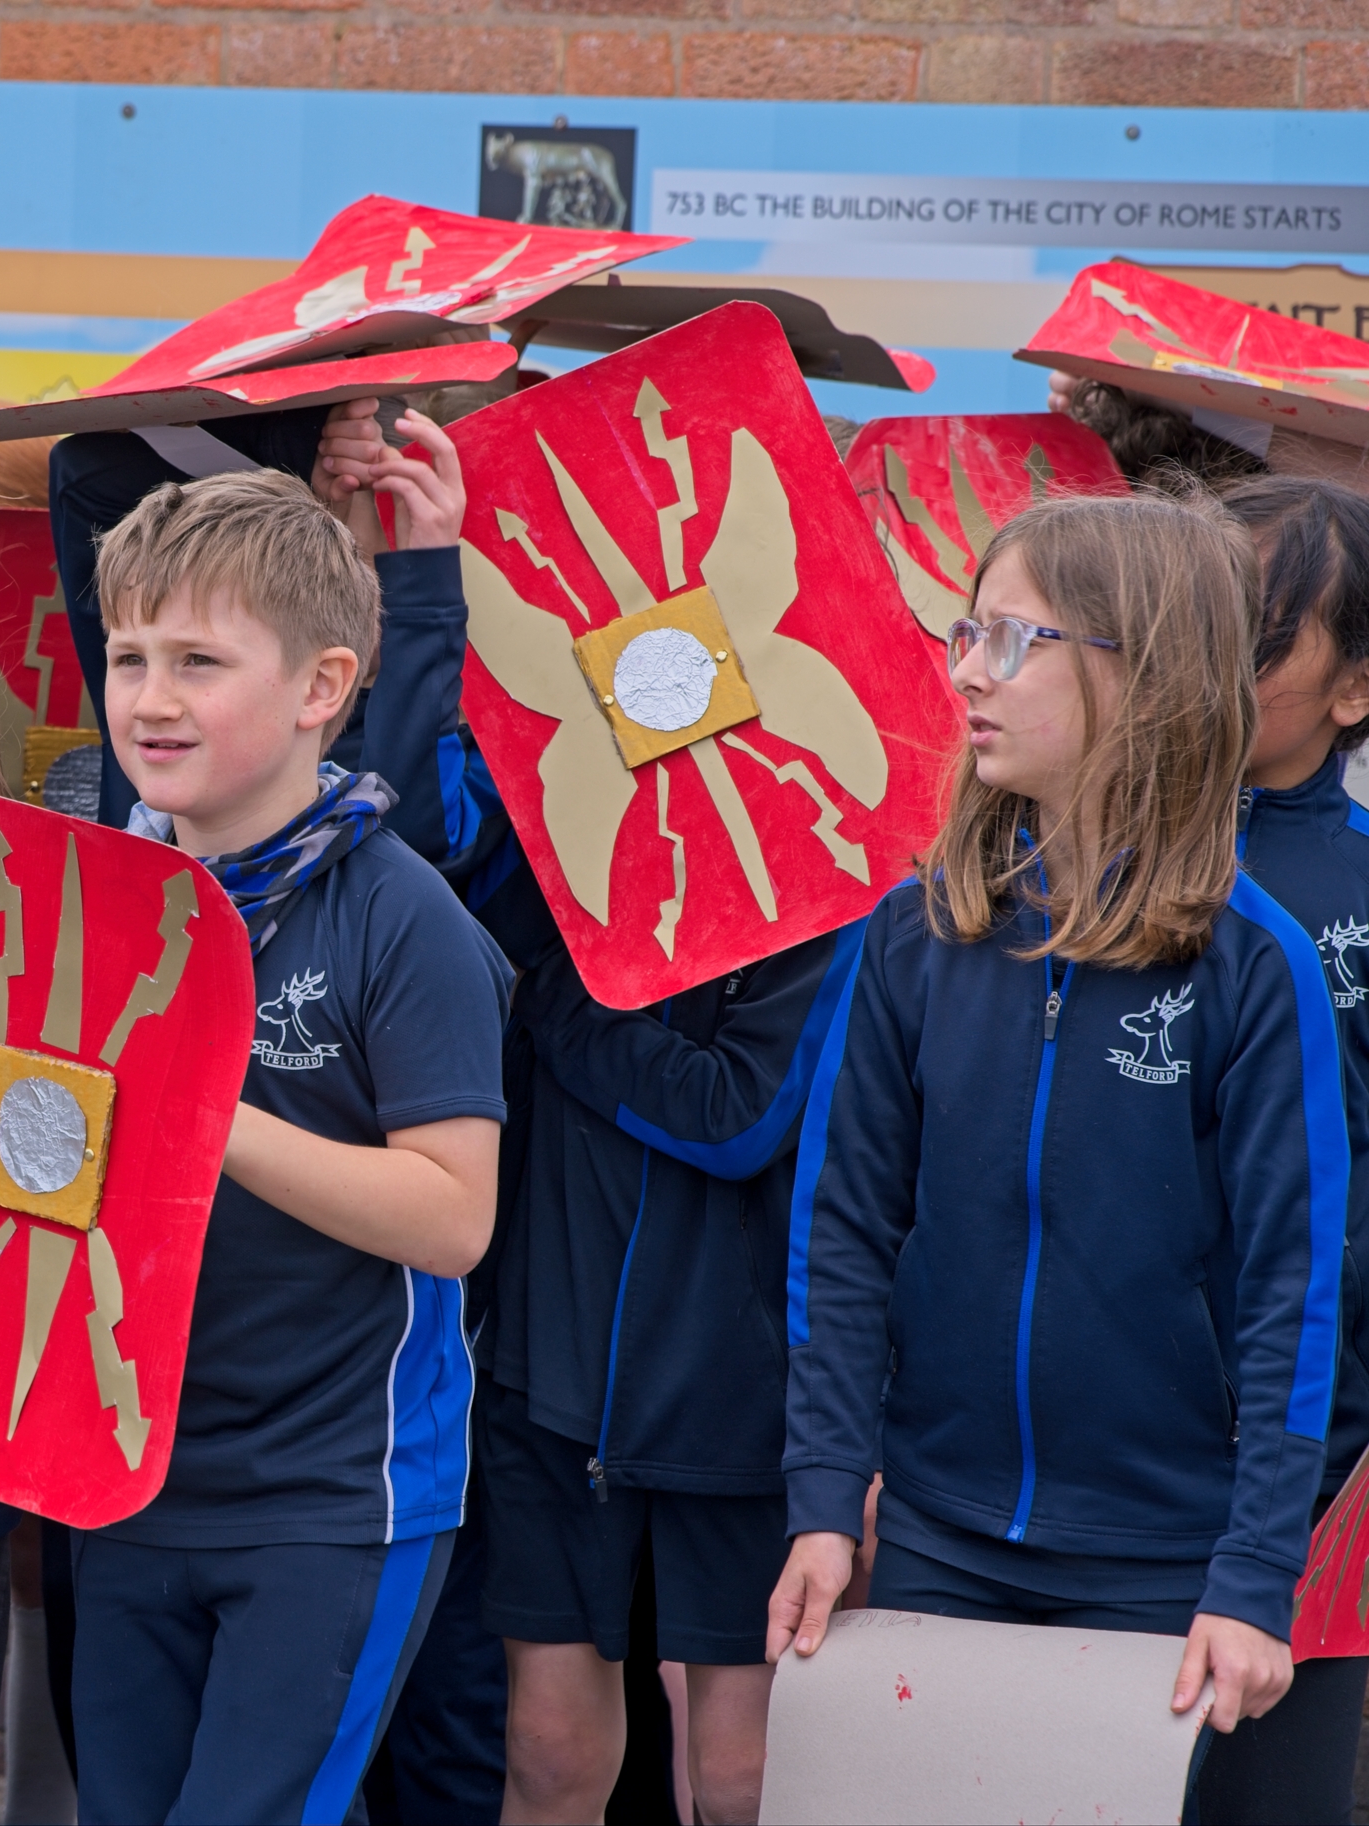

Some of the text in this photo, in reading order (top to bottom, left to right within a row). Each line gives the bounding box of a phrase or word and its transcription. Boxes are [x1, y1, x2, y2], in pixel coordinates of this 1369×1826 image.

[666, 191, 1342, 232] 753 BC THE BUILDING OF THE CITY OF ROME STARTS
[265, 1053, 319, 1067] TELFORD
[1125, 1062, 1175, 1081] TELFORD
